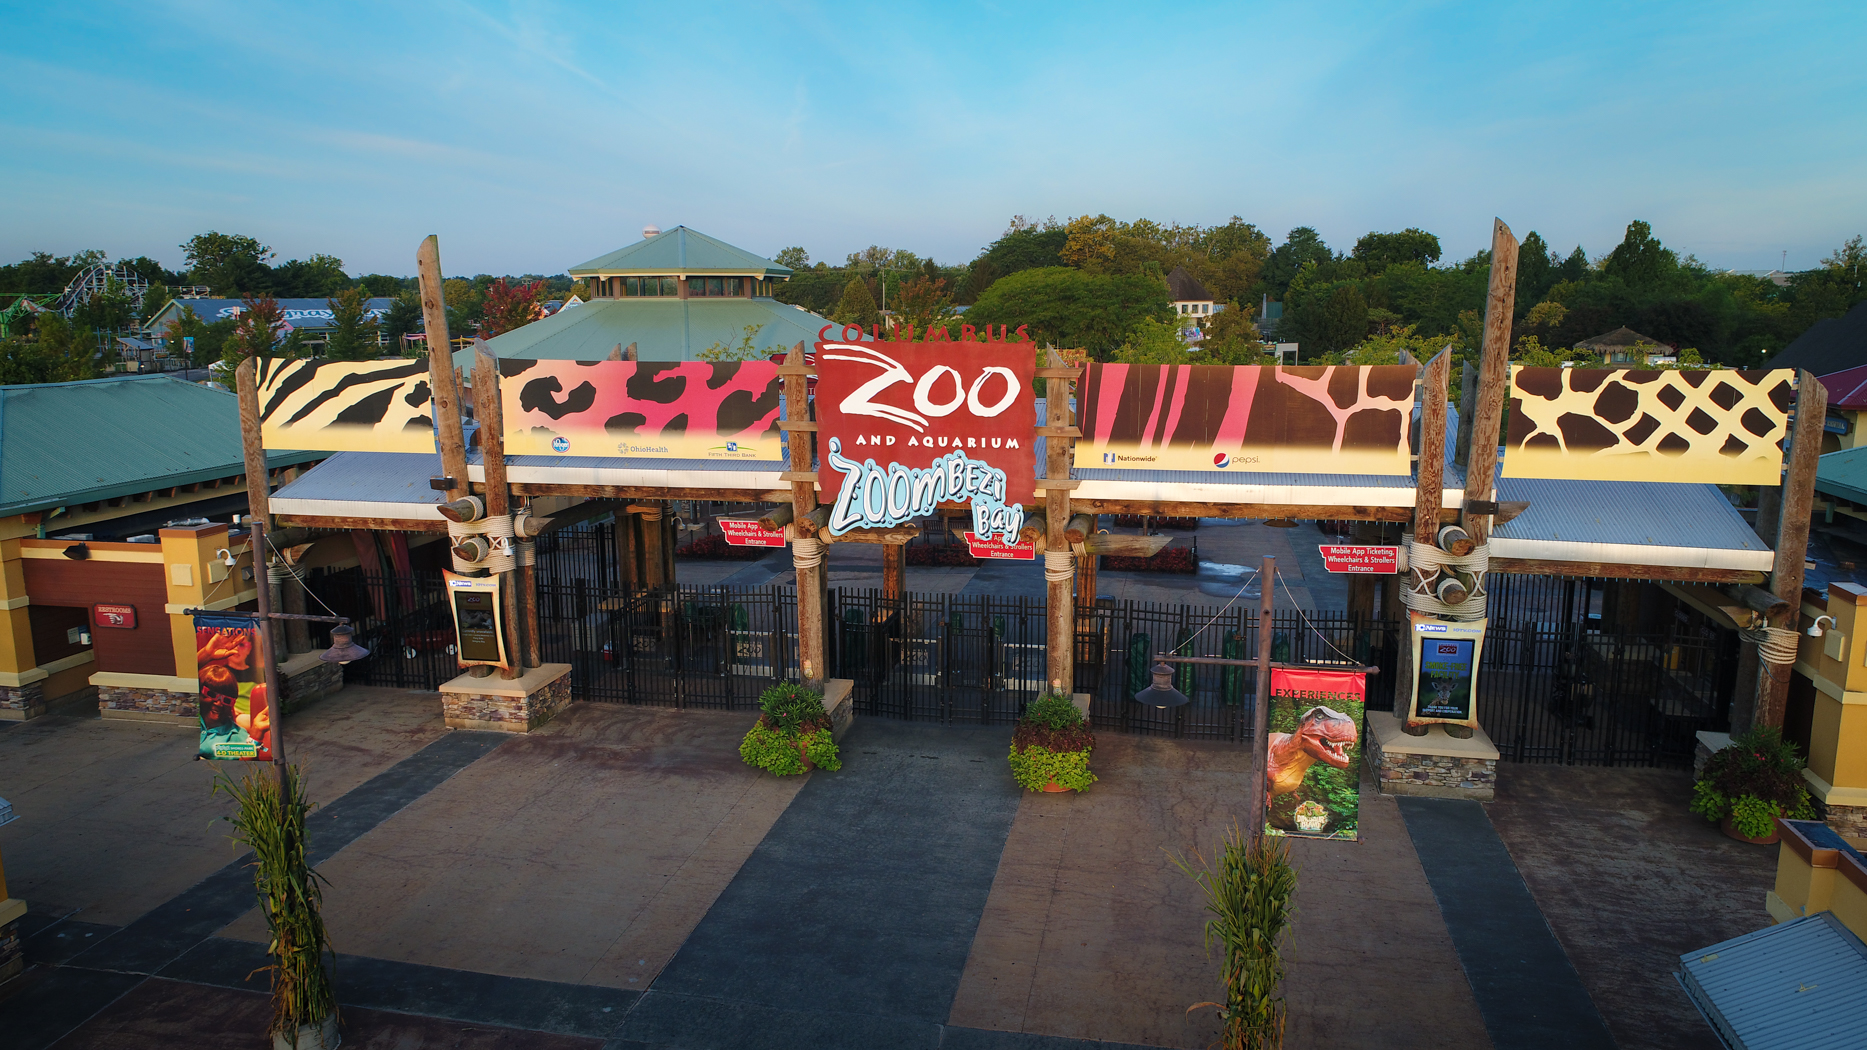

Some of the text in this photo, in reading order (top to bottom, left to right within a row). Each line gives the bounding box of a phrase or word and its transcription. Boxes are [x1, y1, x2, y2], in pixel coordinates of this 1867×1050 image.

[818, 323, 1030, 343] COLUMBUS
[822, 344, 1021, 434] ZOO
[855, 434, 1020, 449] AND AQUARIUM
[630, 445, 669, 455] OhioHealth
[1117, 454, 1156, 463] Nationwide
[747, 523, 759, 531] App
[1352, 547, 1365, 556] App
[1366, 547, 1395, 557] Ticketing,
[1371, 556, 1396, 564] Strollers
[1347, 564, 1374, 572] Entrance
[97, 606, 131, 614] RESTROOMS
[196, 625, 258, 637] SENSATIONS
[1275, 688, 1361, 702] EXPERIENCES
